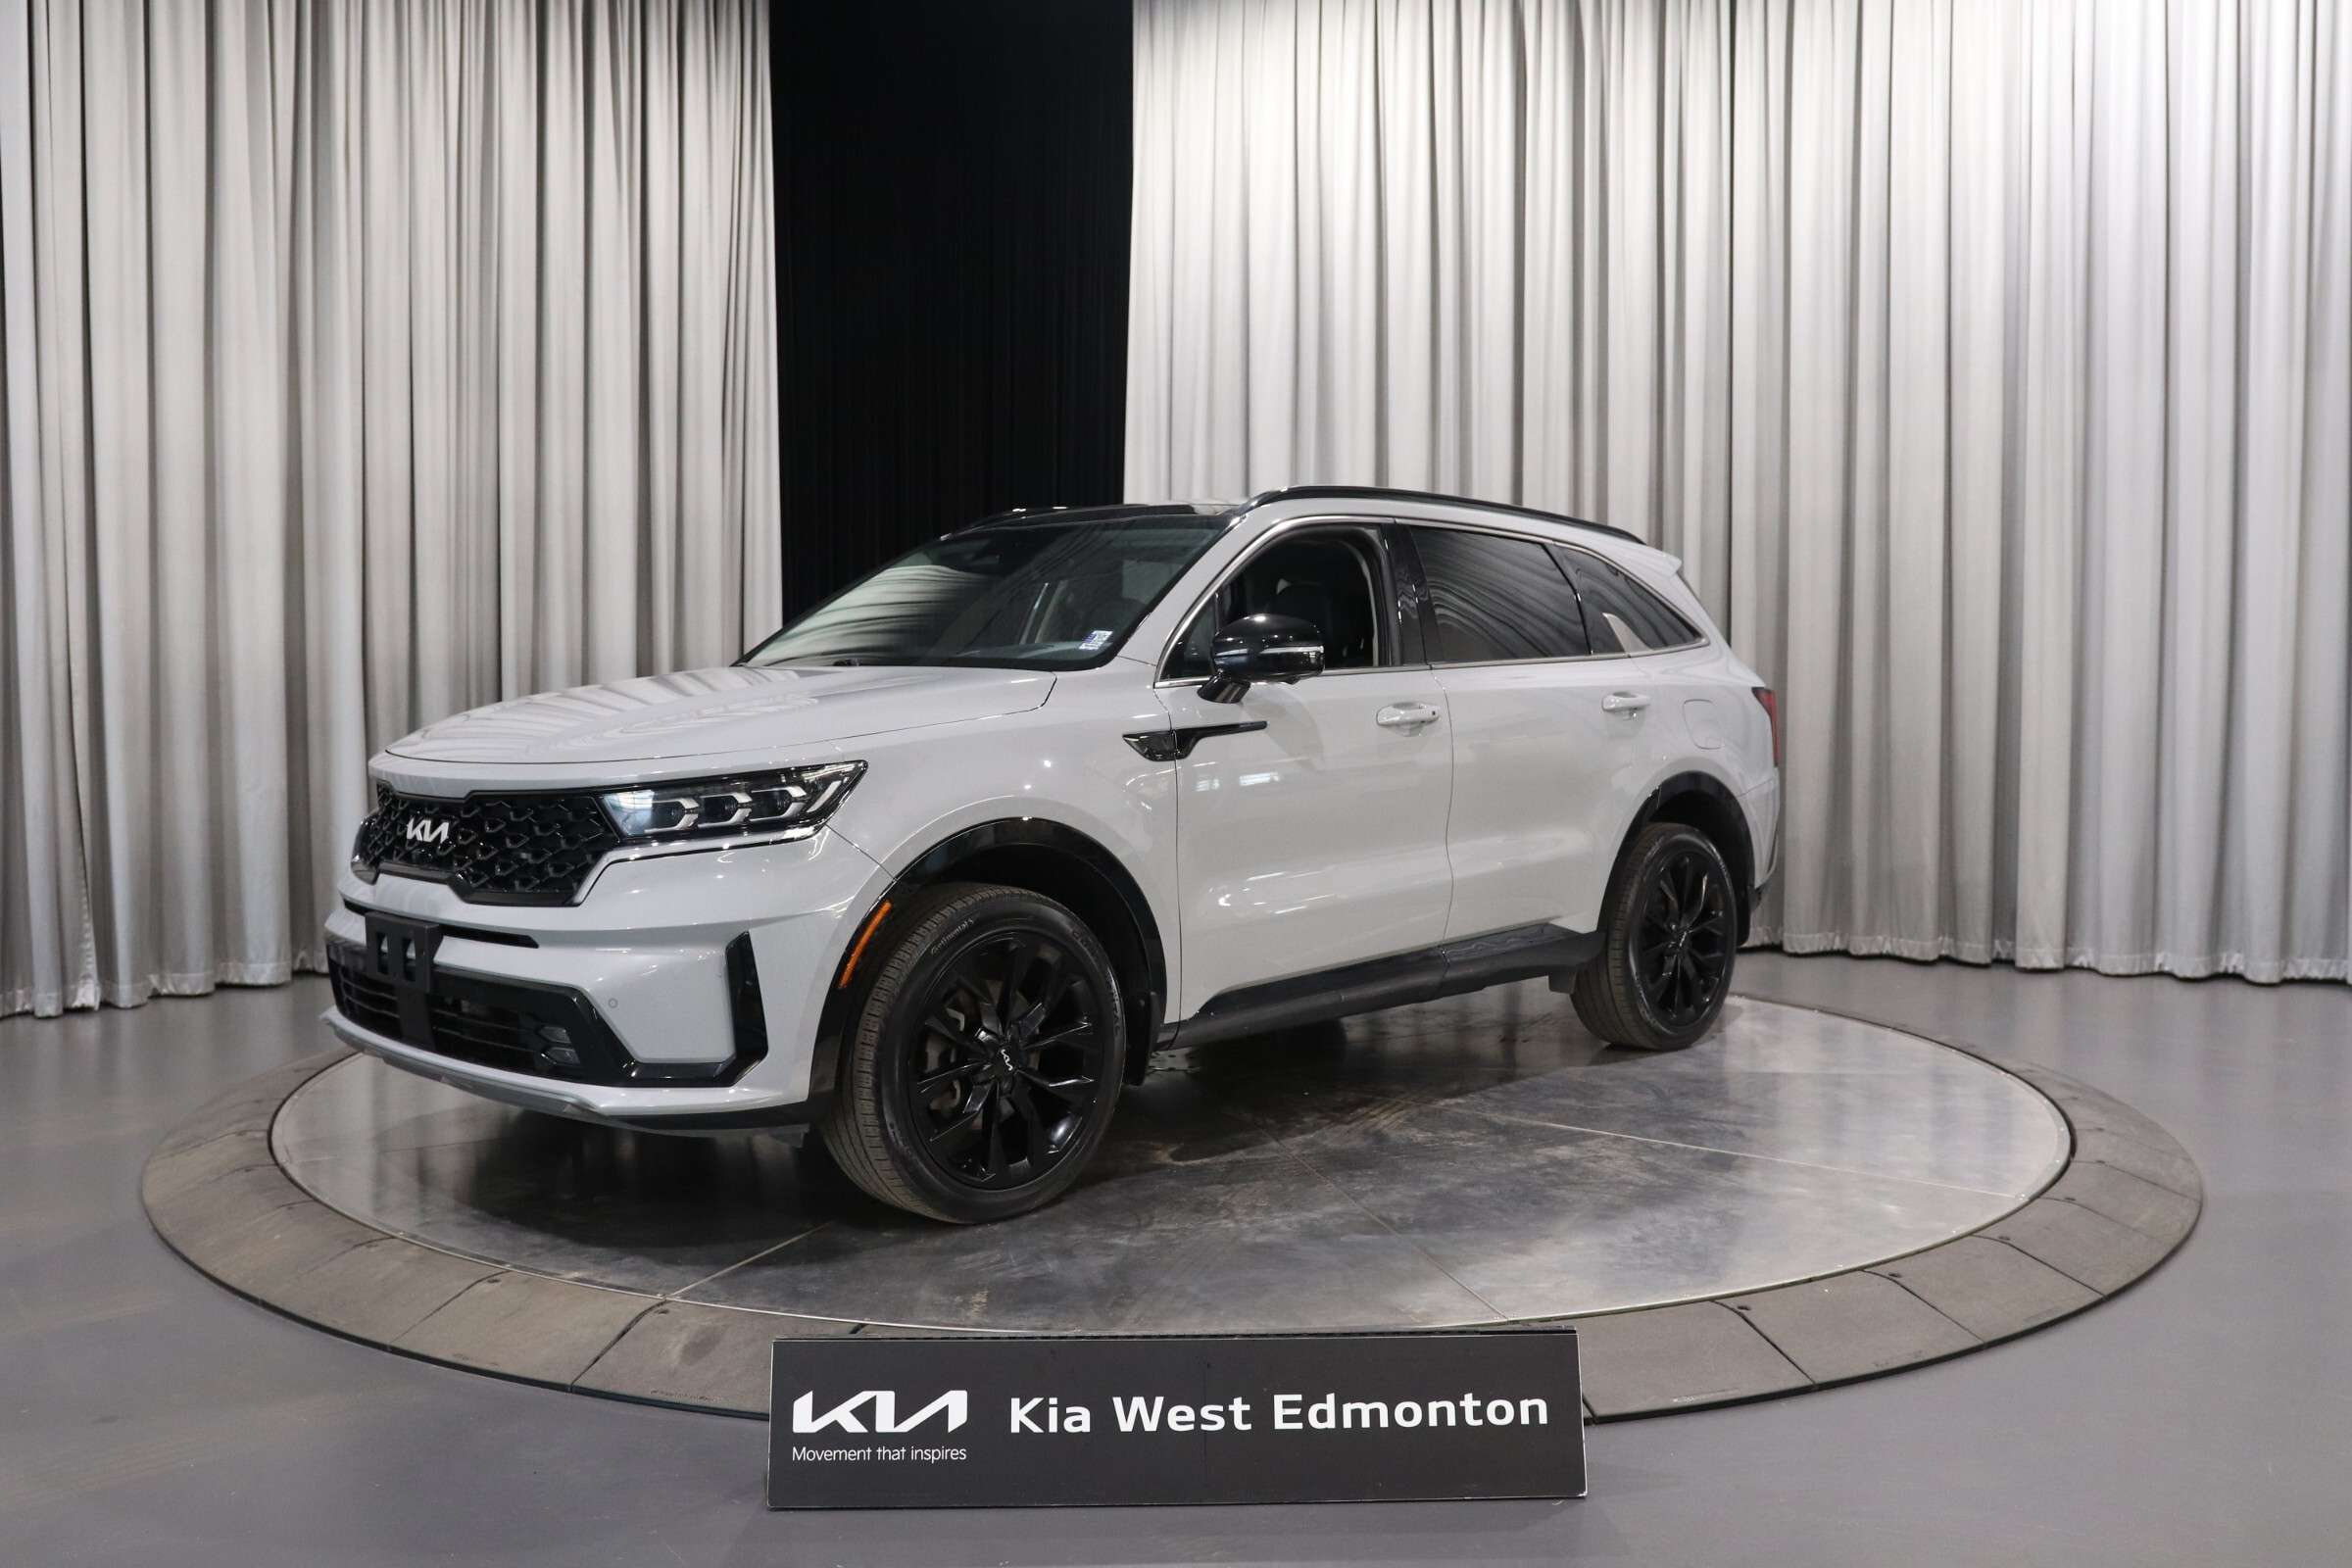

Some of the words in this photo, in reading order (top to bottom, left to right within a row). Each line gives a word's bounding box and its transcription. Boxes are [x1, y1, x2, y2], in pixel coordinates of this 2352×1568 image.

[406, 817, 450, 844] KIA
[792, 1390, 968, 1434] KIA
[1010, 1396, 1091, 1434] Kia
[1112, 1396, 1252, 1433] West
[1273, 1392, 1548, 1430] Edmonton
[792, 1446, 871, 1461] Movement
[876, 1446, 906, 1461] that
[910, 1446, 967, 1464] inspires
